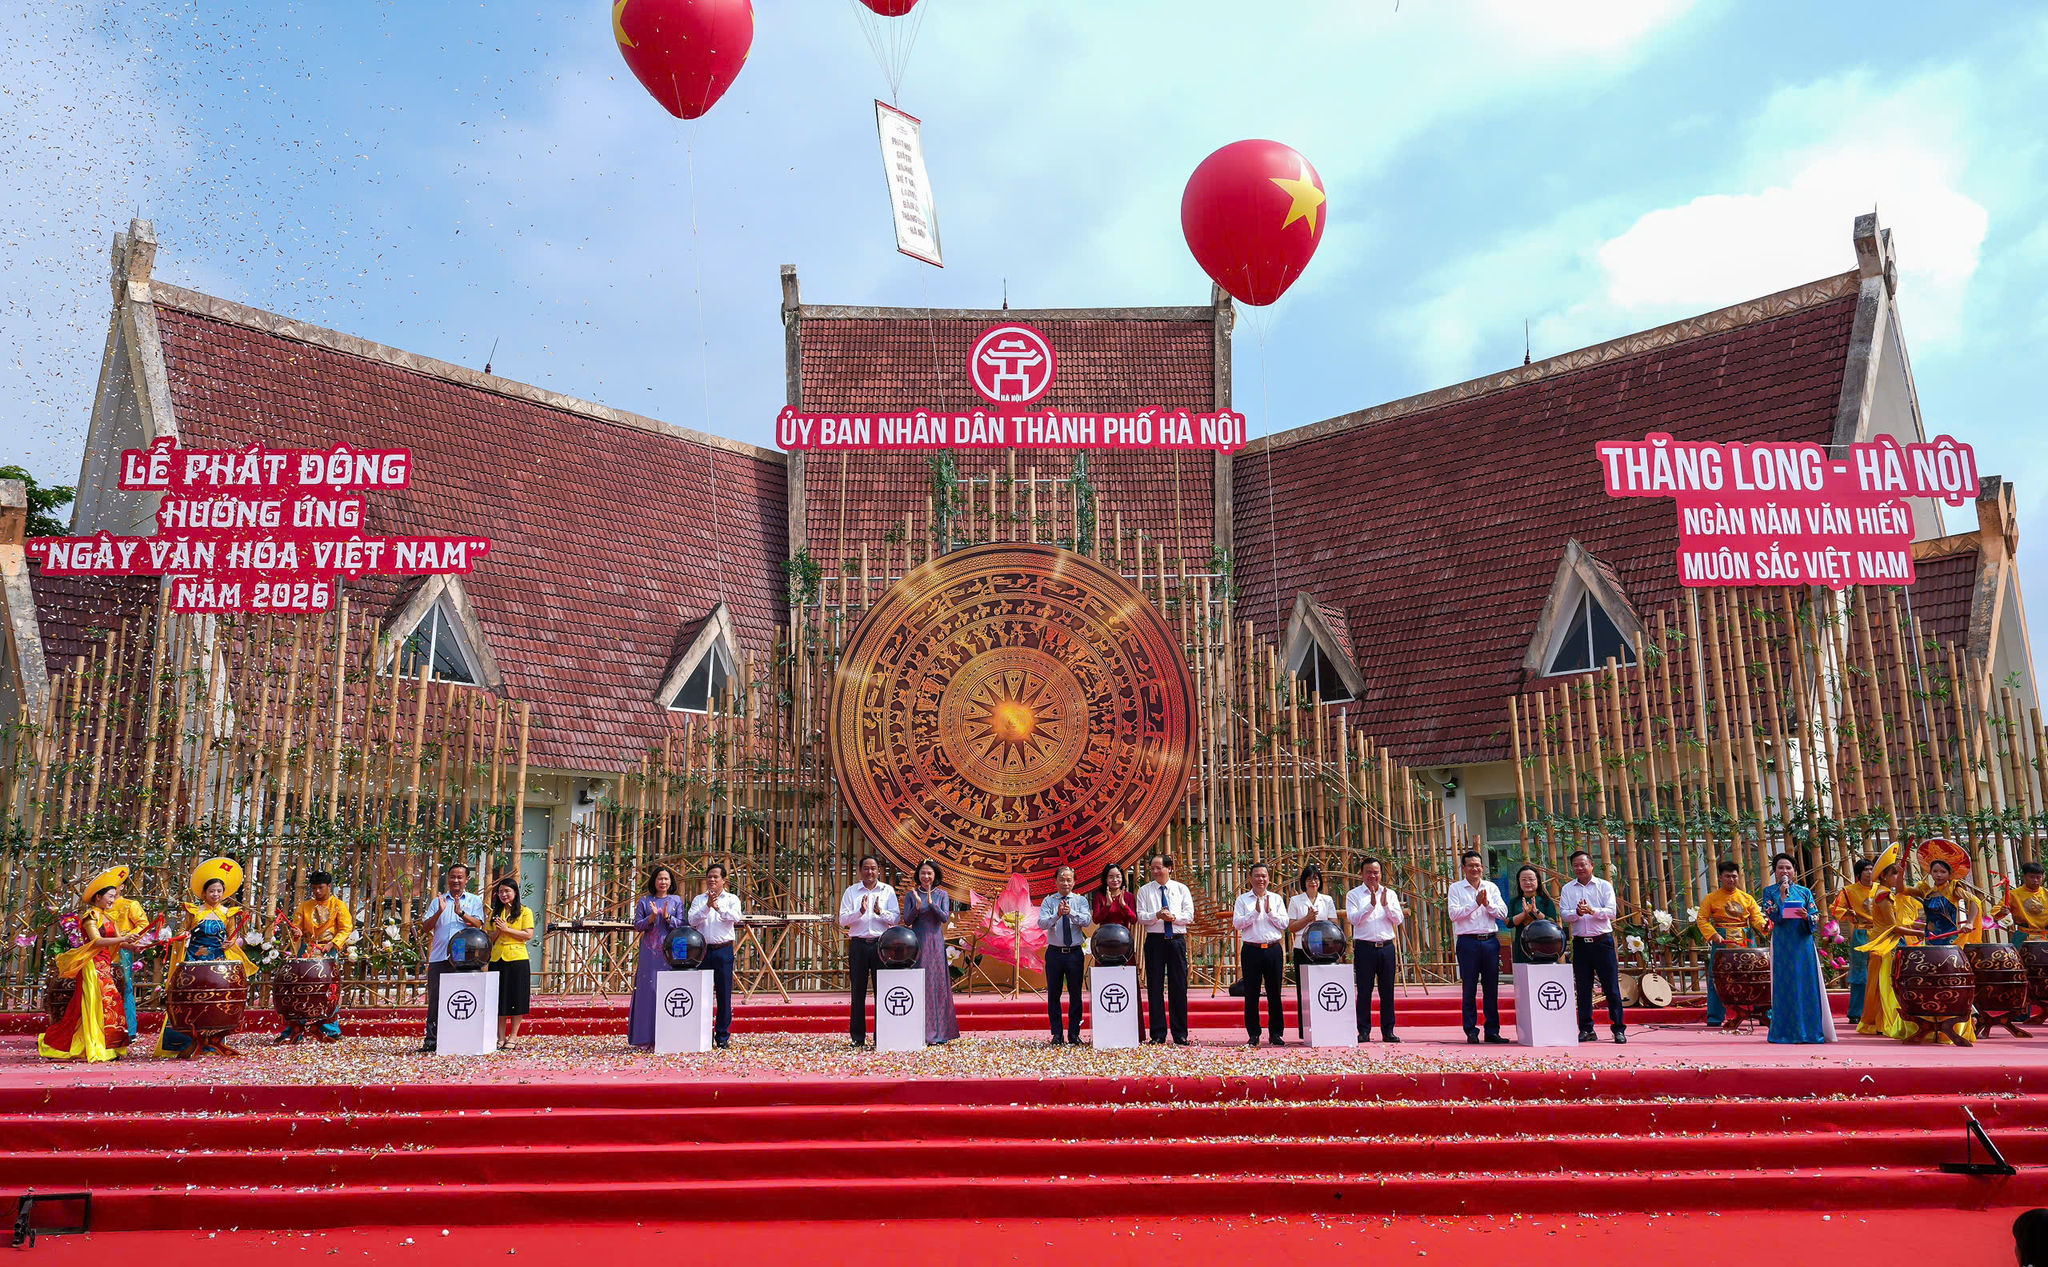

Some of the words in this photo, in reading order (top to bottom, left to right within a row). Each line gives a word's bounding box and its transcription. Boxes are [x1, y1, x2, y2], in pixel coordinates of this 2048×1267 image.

[1000, 393, 1010, 402] HÀ
[1011, 393, 1022, 403] NỘI
[781, 410, 814, 446] ỦY
[821, 419, 871, 444] BAN
[878, 411, 947, 444] NHÂN
[954, 411, 1003, 444] DÂN
[1011, 411, 1096, 444] THÀNH
[1104, 409, 1155, 444] PHỐ
[1159, 408, 1196, 444] HÀ
[1200, 411, 1241, 452] NỘI
[124, 442, 171, 485] LỄ
[183, 447, 286, 485] PHÁT
[299, 446, 405, 492] ĐỘNG
[1602, 437, 1723, 491] THĂNG
[1732, 447, 1824, 491] LONG
[1855, 440, 1908, 492] HÀ
[1913, 441, 1973, 500] NỘI
[162, 494, 280, 527] HƯỞNG
[293, 495, 359, 527] ỨNG
[1684, 502, 1737, 535] NGÀN
[1751, 502, 1801, 535] NĂM
[1805, 502, 1852, 535] VĂN
[1856, 500, 1908, 535] HIẾN
[149, 537, 214, 569] VĂN
[226, 535, 299, 569] HÓA
[311, 535, 384, 575] VIỆT
[1683, 546, 1751, 580] MUÔN
[1754, 541, 1799, 579] SẮC
[1803, 546, 1851, 583] VIỆT
[1858, 551, 1908, 579] NAM
[176, 577, 242, 608] NĂM
[252, 583, 329, 608] 2026
